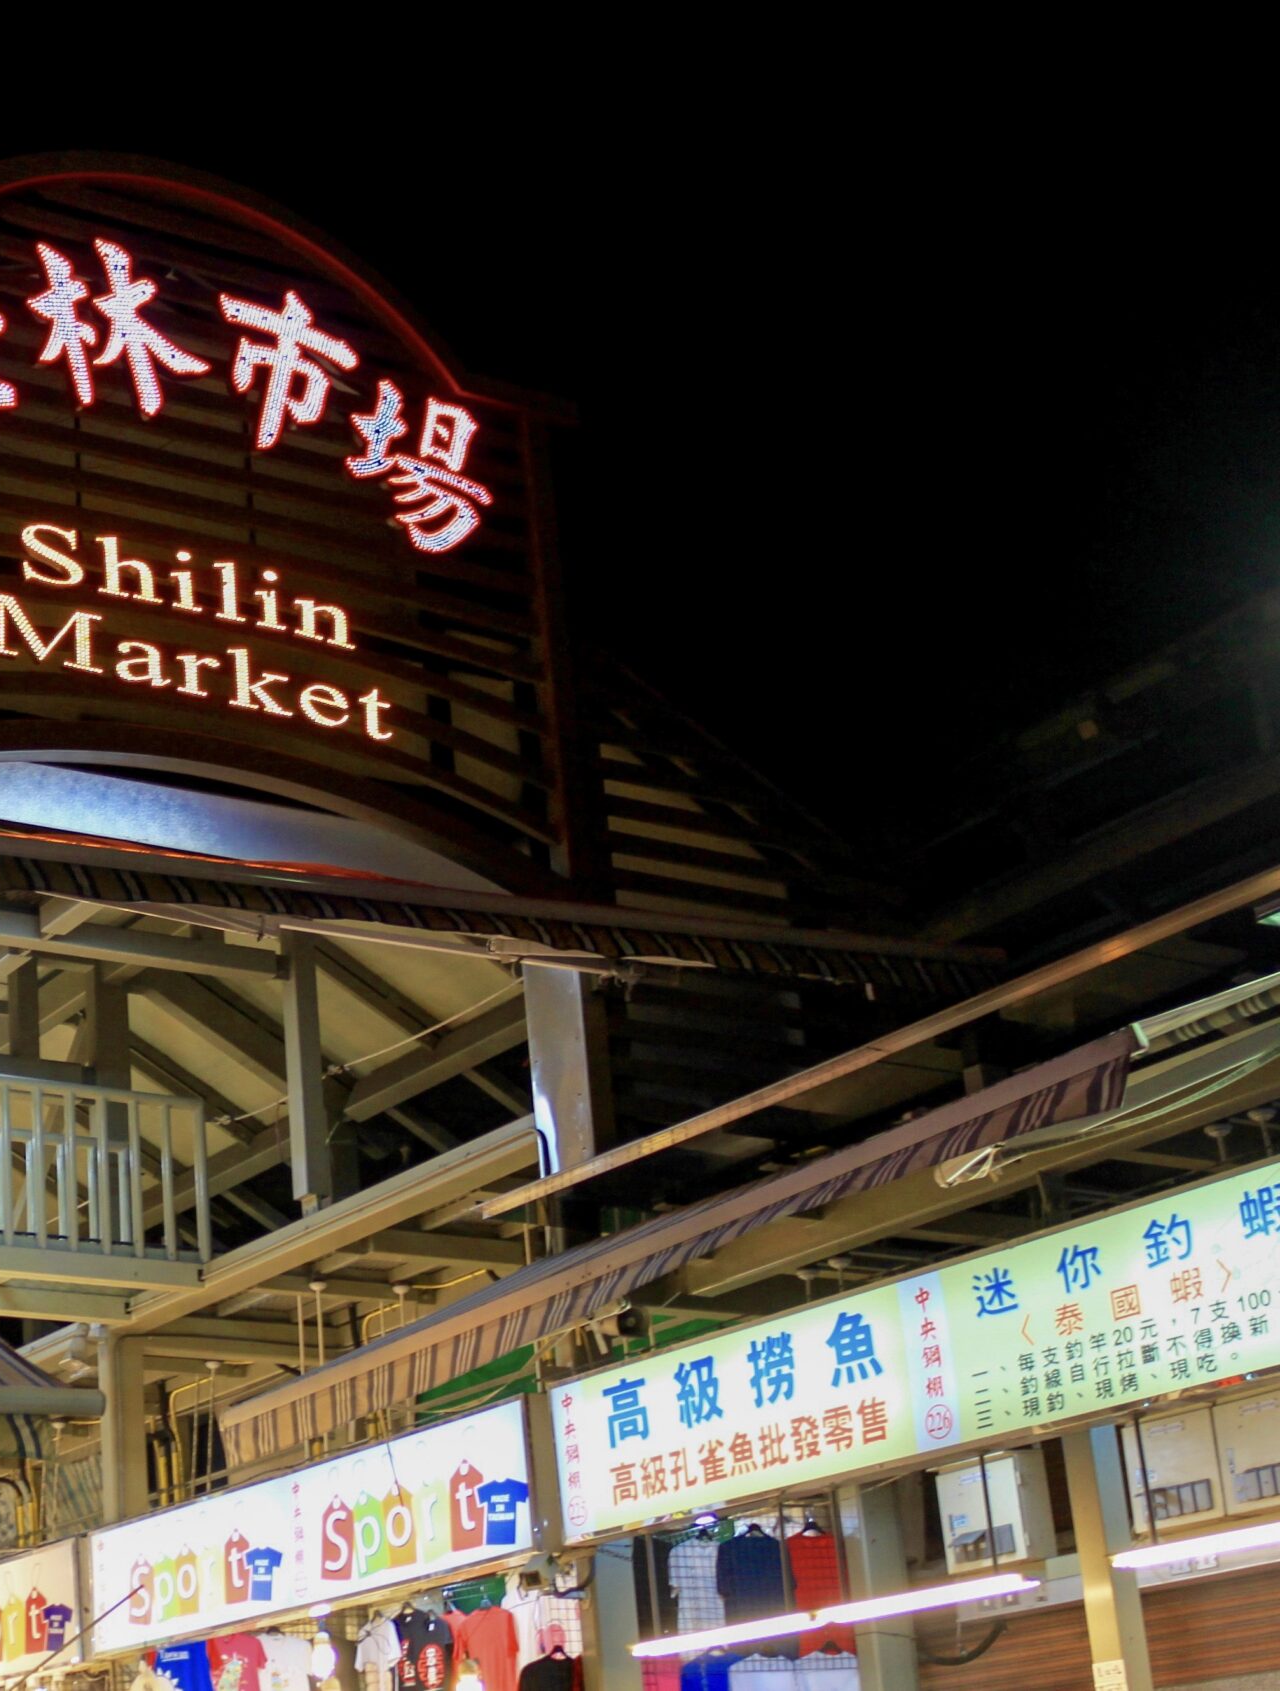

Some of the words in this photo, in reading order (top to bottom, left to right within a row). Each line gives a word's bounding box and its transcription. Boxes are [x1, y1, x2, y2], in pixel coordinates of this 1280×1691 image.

[20, 522, 357, 651] Shilin
[971, 1183, 1280, 1318] 迷你釣蝦
[602, 1311, 885, 1450] 高級撈魚
[926, 1408, 952, 1436] 226
[609, 1396, 889, 1507] 高級孔雀魚批發零售
[324, 1481, 476, 1574] Sport
[129, 1546, 244, 1624] Sport
